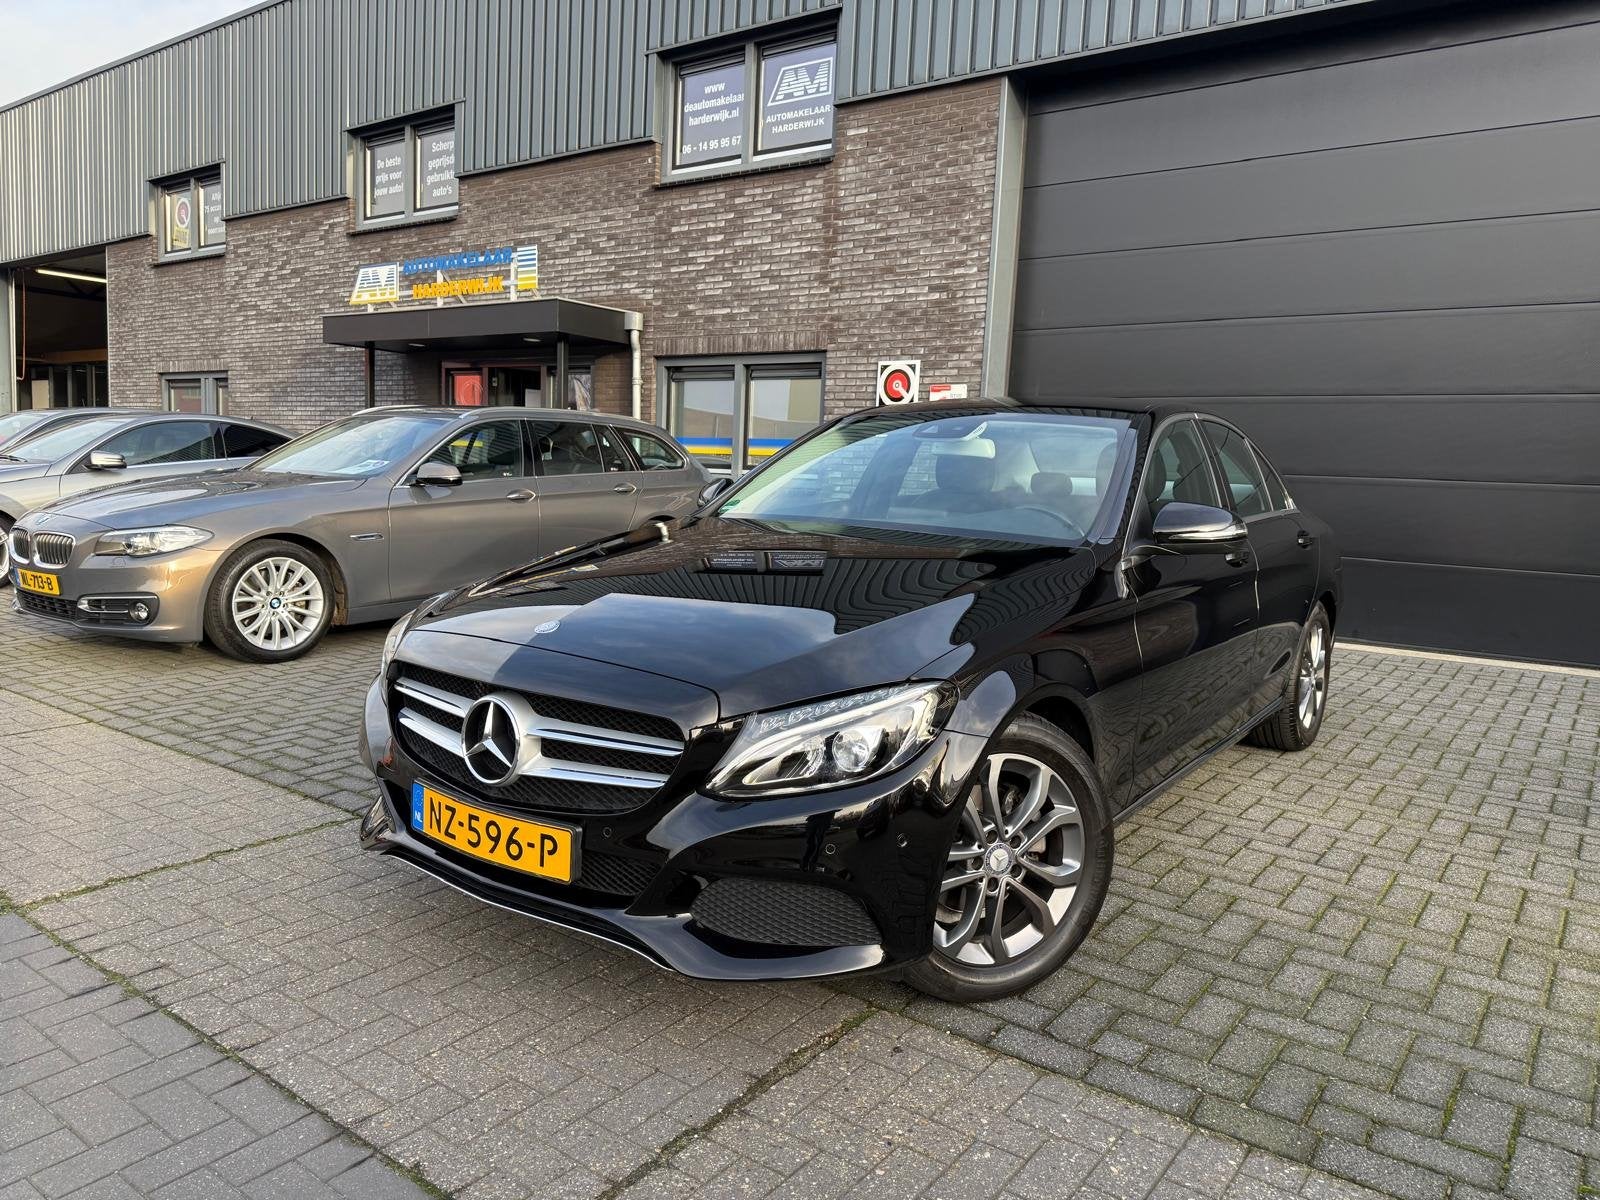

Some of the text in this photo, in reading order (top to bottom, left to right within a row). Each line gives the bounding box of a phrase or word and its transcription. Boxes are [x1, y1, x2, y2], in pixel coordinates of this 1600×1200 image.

[704, 82, 726, 94] www
[684, 93, 745, 113] deautomakelaar
[688, 107, 740, 127] harderwijk.nl
[766, 104, 831, 123] AUTOMAKELAAR
[772, 117, 825, 134] HARDERWIJK
[431, 140, 455, 153] Scherp
[682, 144, 692, 154] 06
[699, 140, 709, 152] 14
[709, 138, 719, 150] 95
[720, 137, 730, 148] 95
[731, 135, 742, 146] 67
[385, 155, 402, 168] beste
[375, 170, 402, 185] prijs voor
[432, 185, 453, 198] auto's
[403, 247, 512, 275] AUTOMAKELAAR
[413, 275, 504, 299] HARDERWIJK
[414, 810, 423, 823] NL
[429, 796, 558, 868] NZ-596-P
